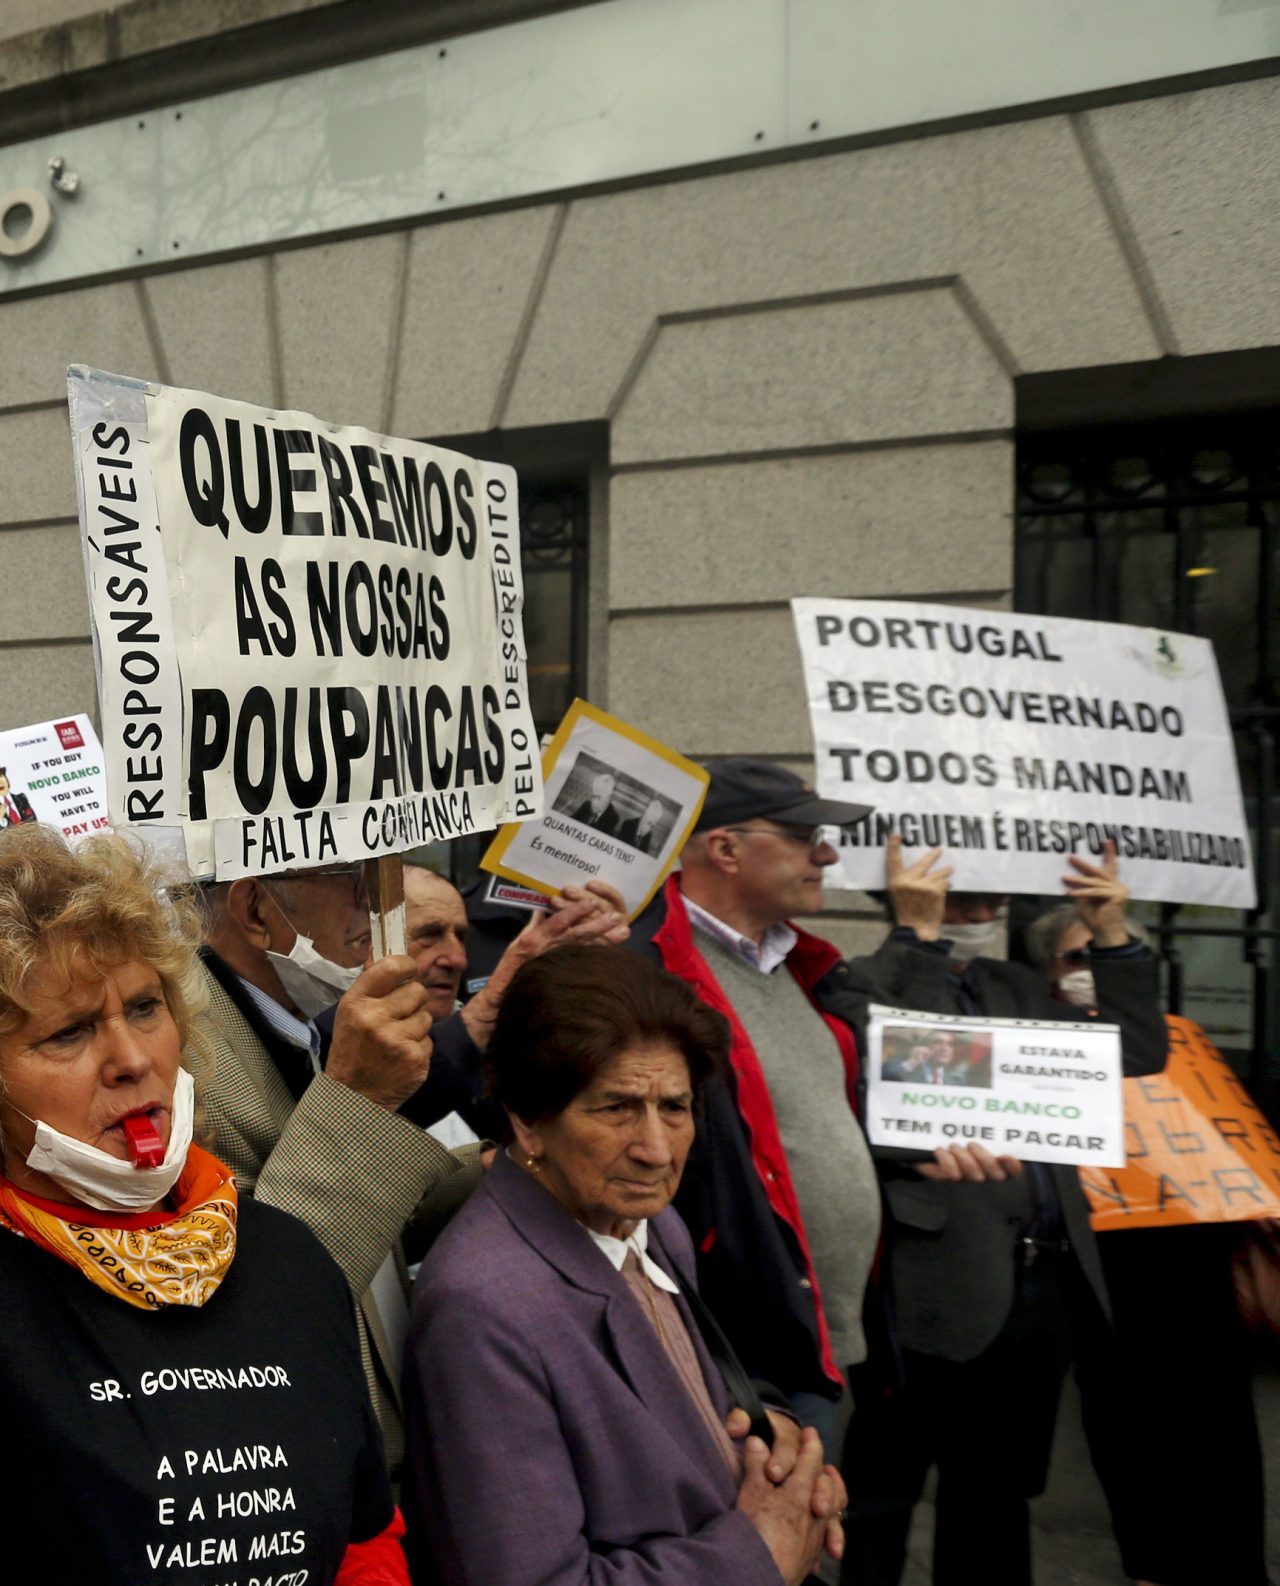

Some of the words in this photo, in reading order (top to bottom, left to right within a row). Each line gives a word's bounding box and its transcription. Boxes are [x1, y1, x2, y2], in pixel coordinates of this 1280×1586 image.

[179, 407, 478, 561] QUEREMOS
[234, 555, 297, 658] AS
[306, 559, 451, 661] NOSSAS
[486, 478, 523, 711] DESCREDITO
[87, 420, 164, 822] RESPONSÁVEIS
[816, 615, 1064, 663] PORTUGAL
[828, 680, 1184, 738] DESGOVERNADO
[27, 776, 60, 791] NOVO
[63, 765, 100, 782] BANCO
[31, 762, 41, 771] IF
[43, 756, 62, 769] YOU
[64, 752, 82, 764] BUY
[512, 728, 536, 817] PELO
[829, 748, 999, 787] TODOS
[1013, 755, 1193, 803] MANDAM
[51, 790, 70, 803] YOU
[72, 786, 94, 798] WILL
[60, 804, 86, 818] HAVE
[87, 801, 100, 811] TO
[62, 823, 88, 838] PAY
[241, 810, 337, 869] FALTA
[361, 791, 475, 852] CONFIANÇA
[543, 816, 589, 844] QUANTAS
[588, 836, 616, 856] CARAS
[614, 848, 636, 865] TENS?
[994, 811, 1009, 851] É
[1018, 817, 1246, 870] RESPONSABILIZADO
[530, 835, 545, 850] És
[544, 845, 601, 877] mentiroso!
[1019, 1045, 1087, 1060] ESTAVA
[998, 1063, 1109, 1082] GARANTIDO
[901, 1092, 978, 1111] NOVO
[984, 1097, 1083, 1120] BANCO
[880, 1117, 932, 1135] TEM
[941, 1122, 995, 1141] QUE
[1005, 1128, 1107, 1151] PAGAR
[89, 1379, 132, 1402] SR.
[140, 1365, 291, 1396] GOVERNADOR
[156, 1455, 175, 1480] A
[184, 1445, 288, 1476] PALAVRA
[158, 1497, 175, 1525] E
[188, 1497, 205, 1522] A
[217, 1487, 296, 1518] HONRA
[146, 1538, 238, 1569] VALEM
[248, 1530, 306, 1561] MAIS
